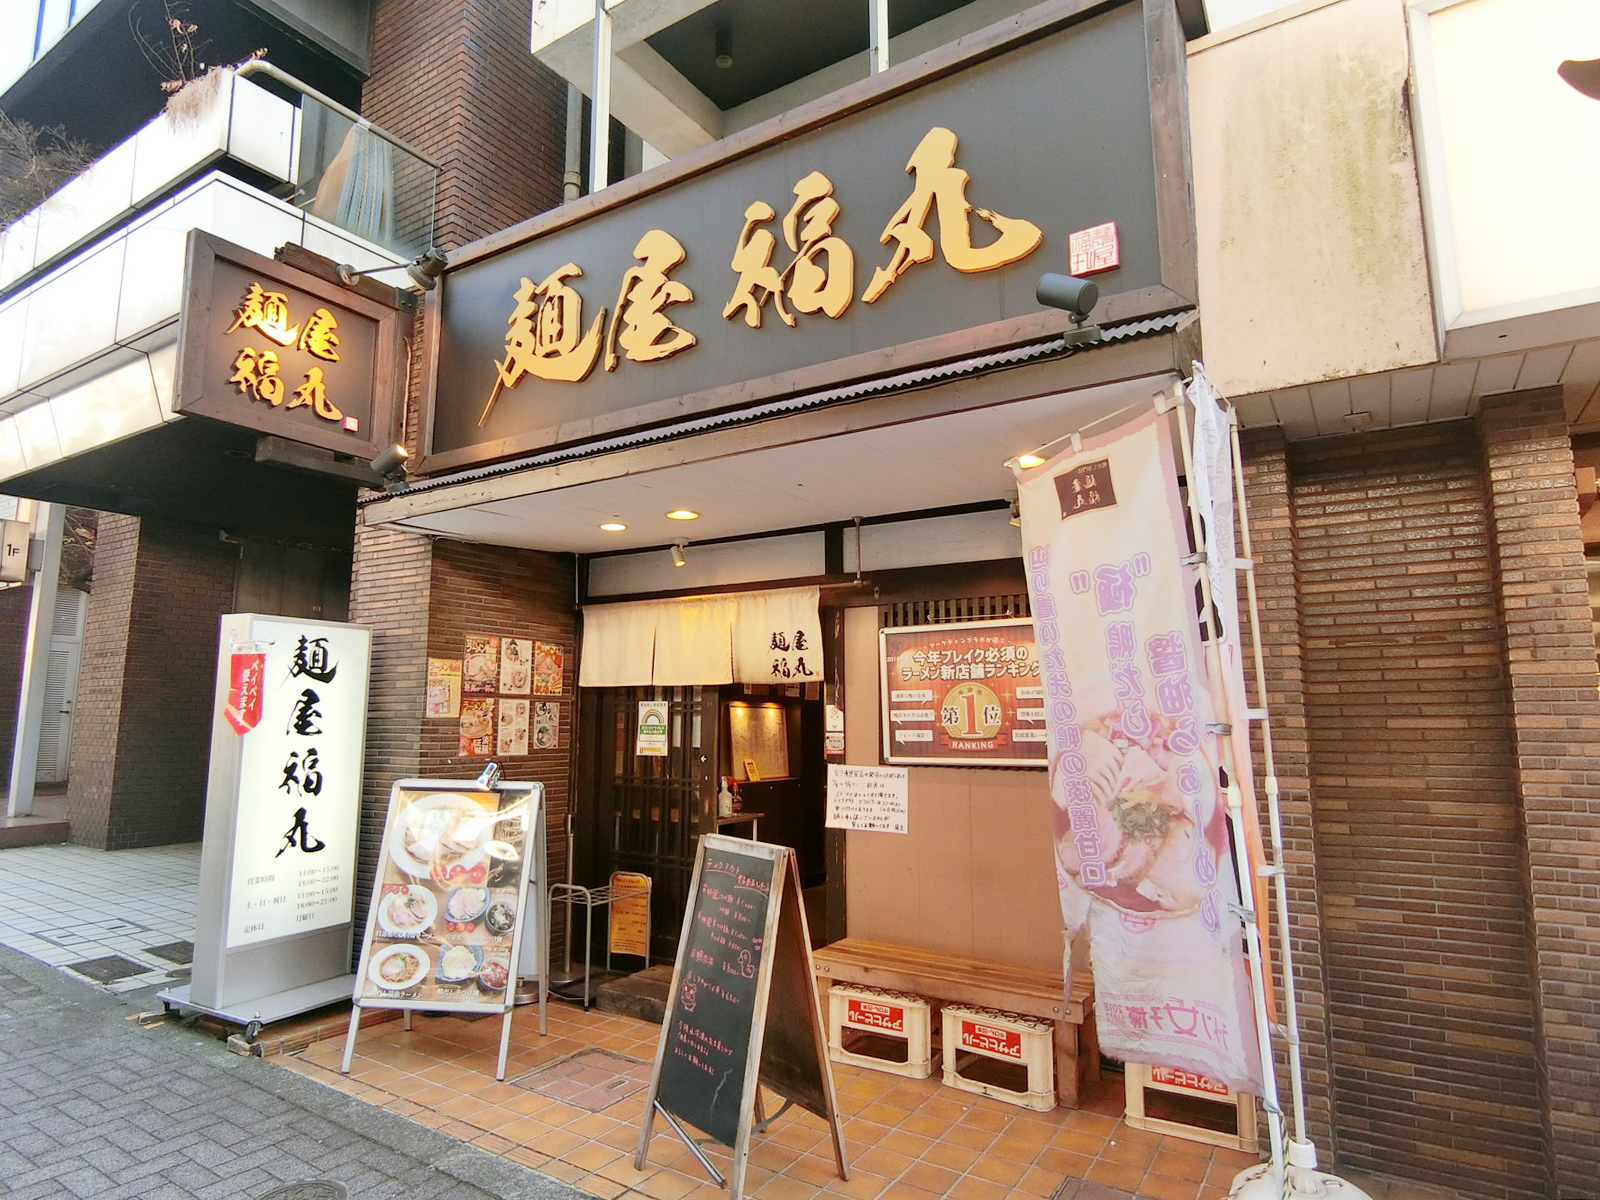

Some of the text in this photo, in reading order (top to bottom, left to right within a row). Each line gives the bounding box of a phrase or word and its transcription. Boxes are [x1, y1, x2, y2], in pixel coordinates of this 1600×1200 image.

[478, 126, 1044, 428] 麺屋福丸
[224, 281, 341, 361] 麺屋
[229, 346, 344, 421] 福丸
[6, 543, 20, 557] 1F
[766, 630, 809, 655] 麺屋
[770, 656, 814, 679] 福丸
[912, 646, 1029, 666] 今年ブレイク必須の
[275, 634, 340, 858] 麺屋福丸
[951, 740, 995, 750] RANKING
[849, 1010, 903, 1031] アサヒビール
[962, 1031, 1021, 1057] アサヒビール
